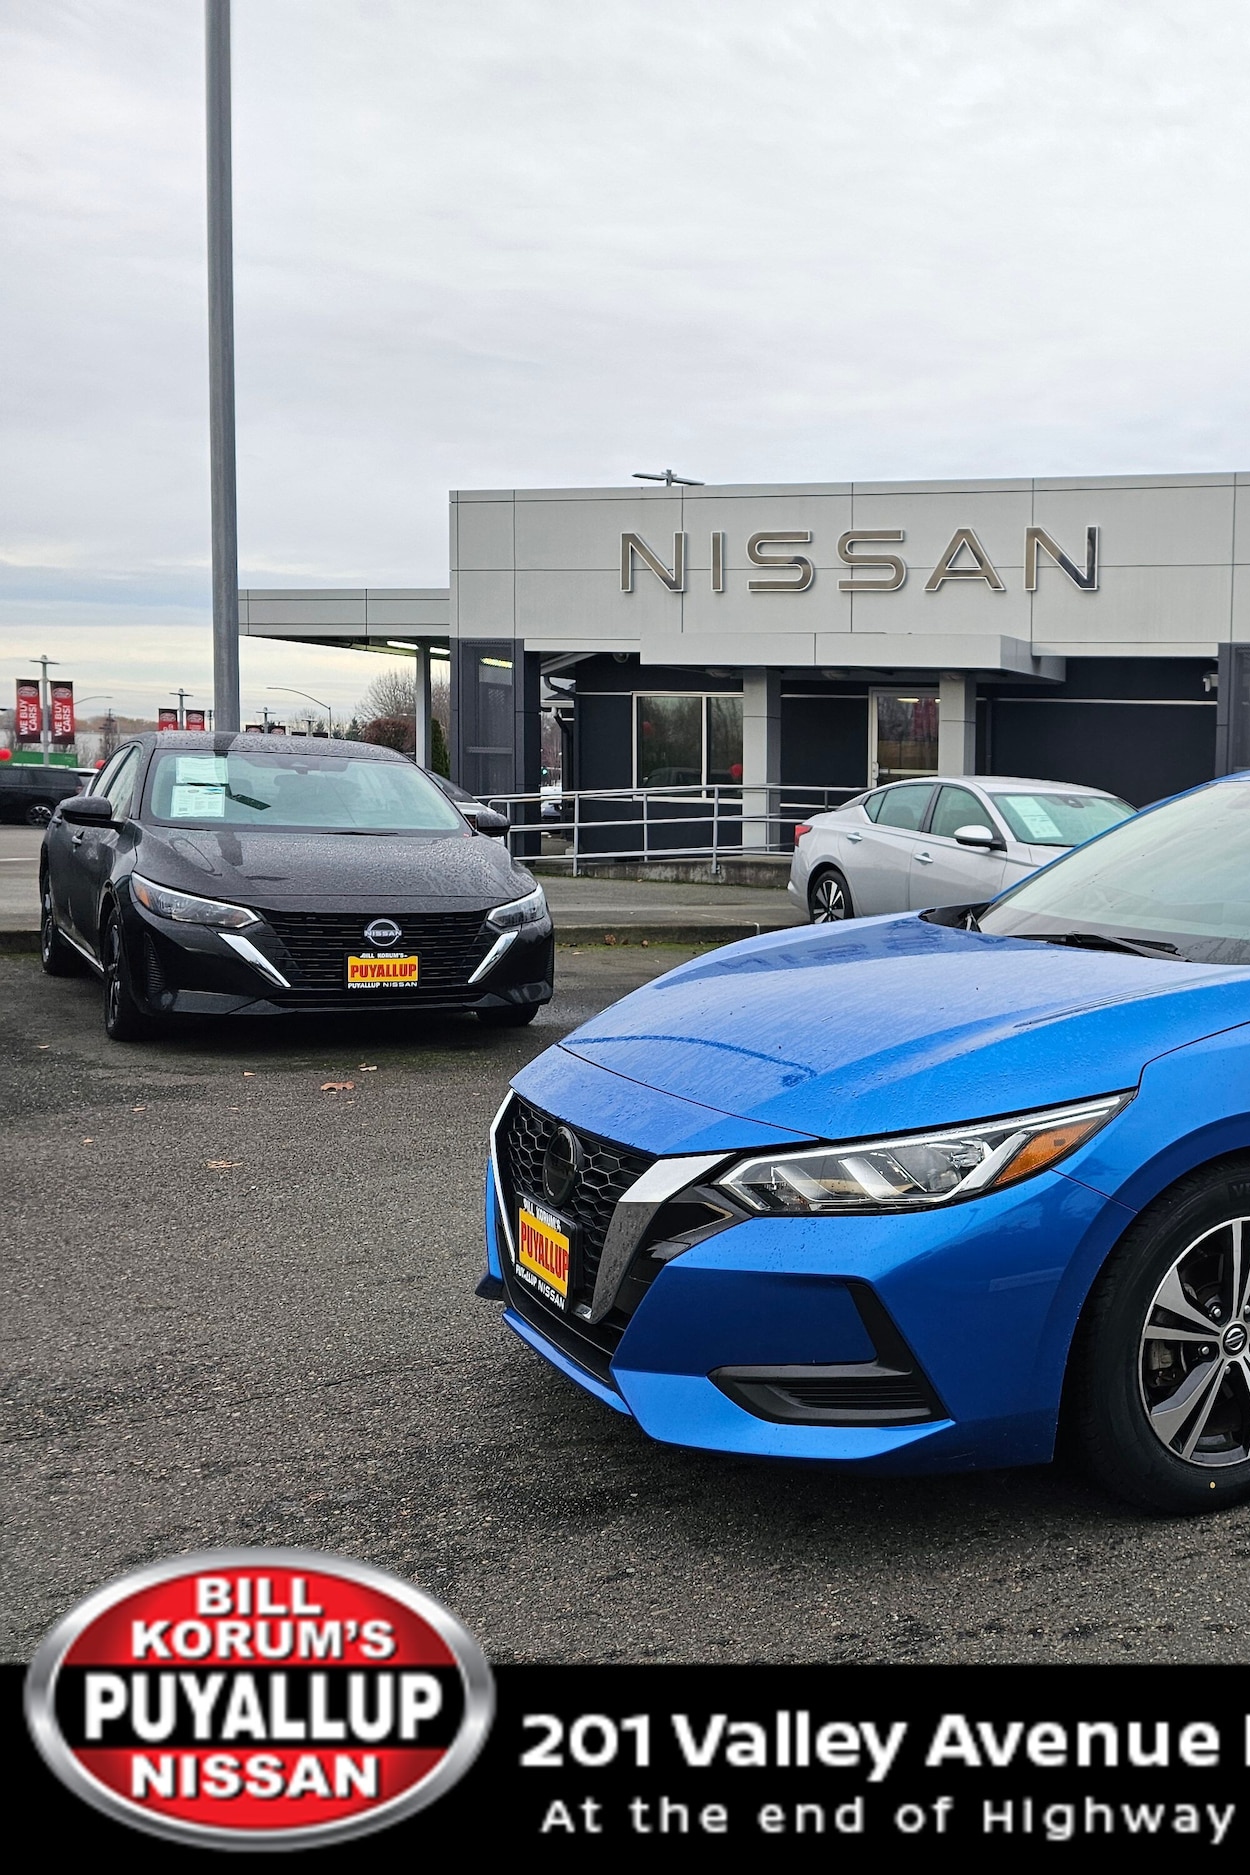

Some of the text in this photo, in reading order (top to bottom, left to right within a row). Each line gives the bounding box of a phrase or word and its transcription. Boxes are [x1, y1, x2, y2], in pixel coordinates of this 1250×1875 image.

[620, 526, 1101, 593] NISSAN
[20, 699, 28, 735] WE BUY
[29, 704, 37, 731] CARS!
[54, 701, 62, 737] WE BUY
[63, 705, 71, 732] CARS!
[351, 964, 416, 978] PUYALLUP
[521, 1220, 569, 1282] PUYALLUP
[538, 1279, 565, 1310] NISSAN
